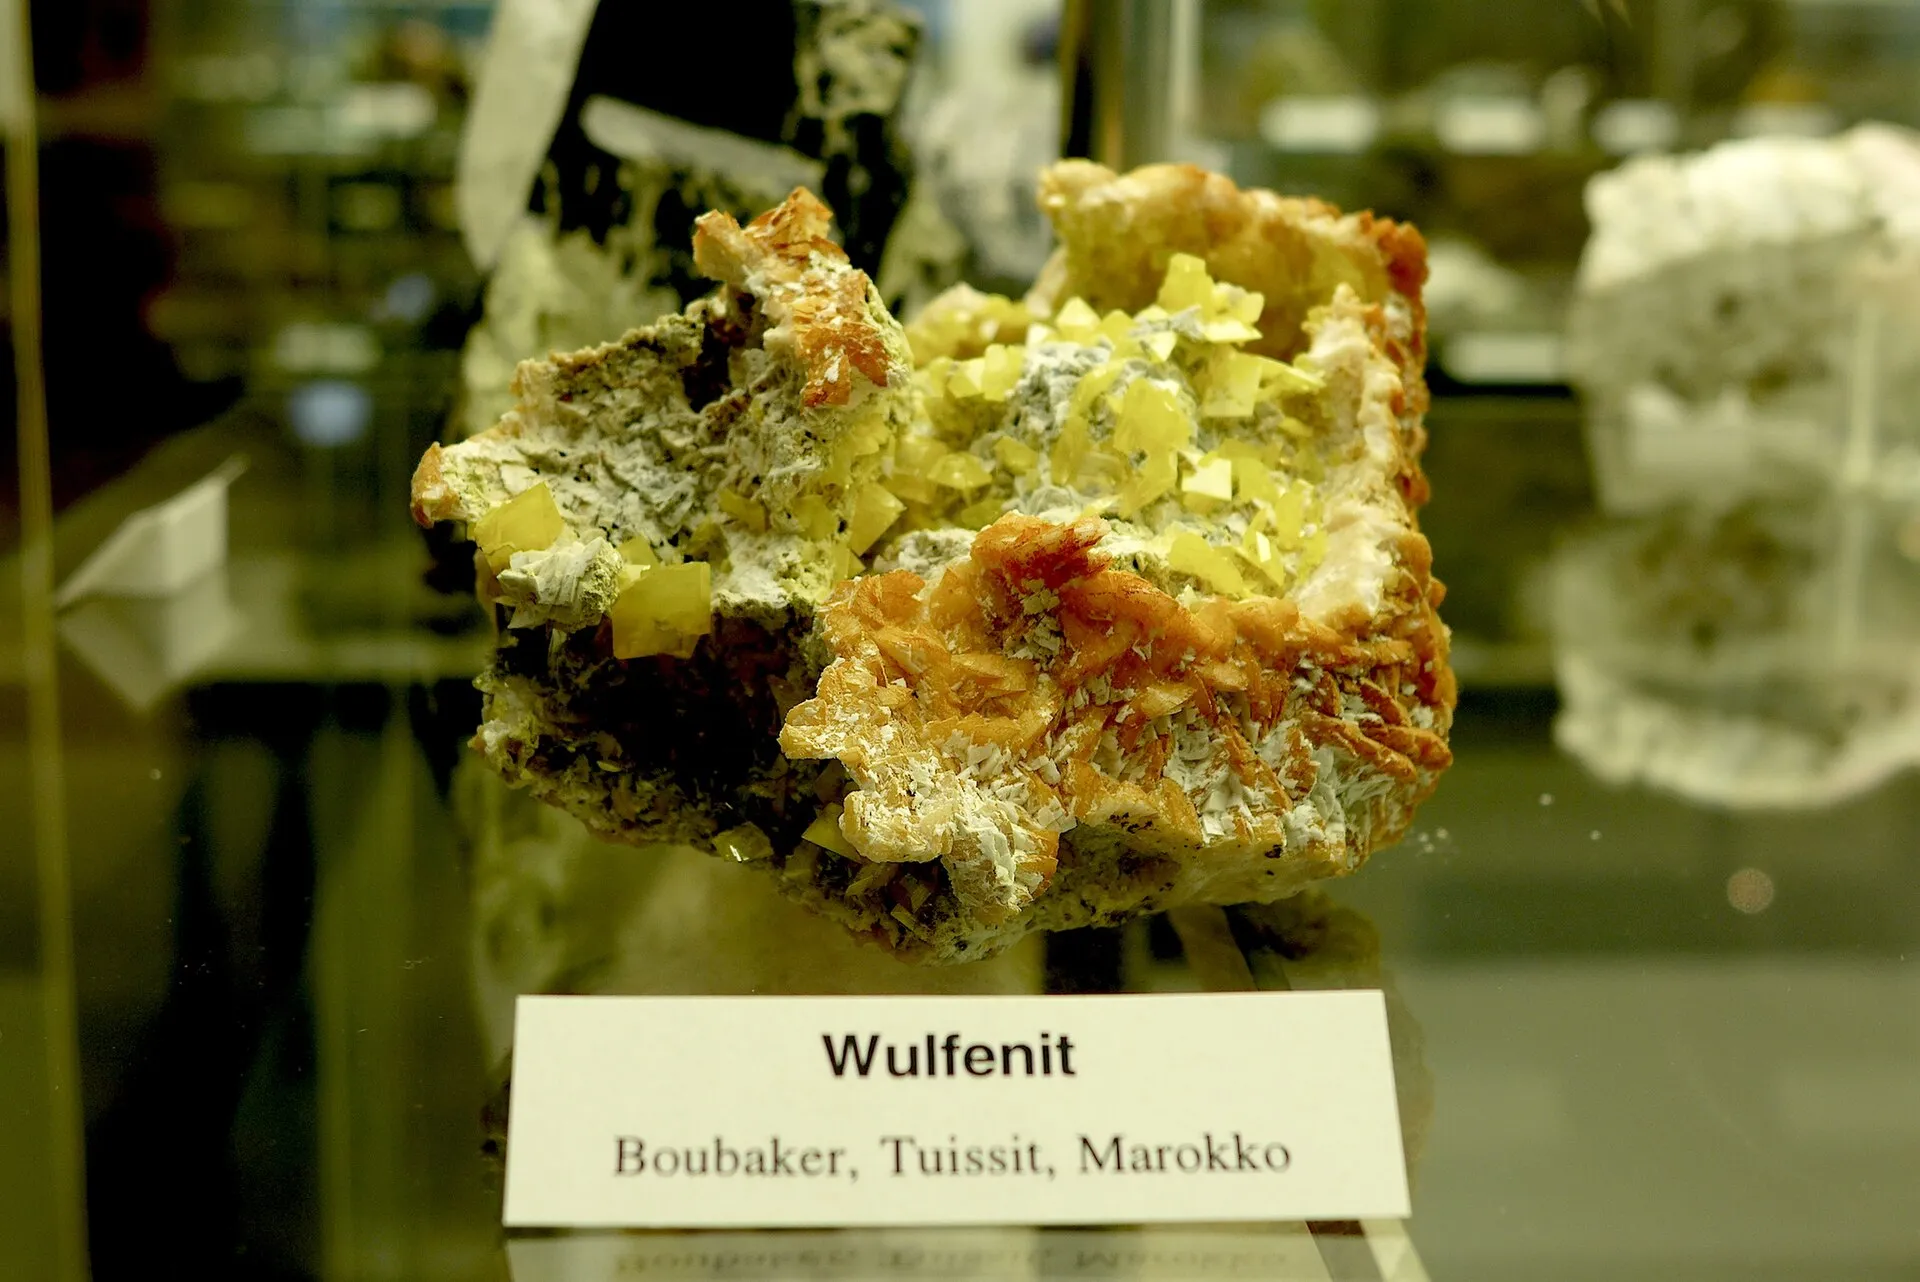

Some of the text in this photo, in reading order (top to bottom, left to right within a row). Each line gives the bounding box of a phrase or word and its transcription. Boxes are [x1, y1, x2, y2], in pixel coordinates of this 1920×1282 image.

[821, 1033, 1077, 1078] Wulfenit
[614, 1132, 1292, 1179] Boubaker, Tuissit, Marokko
